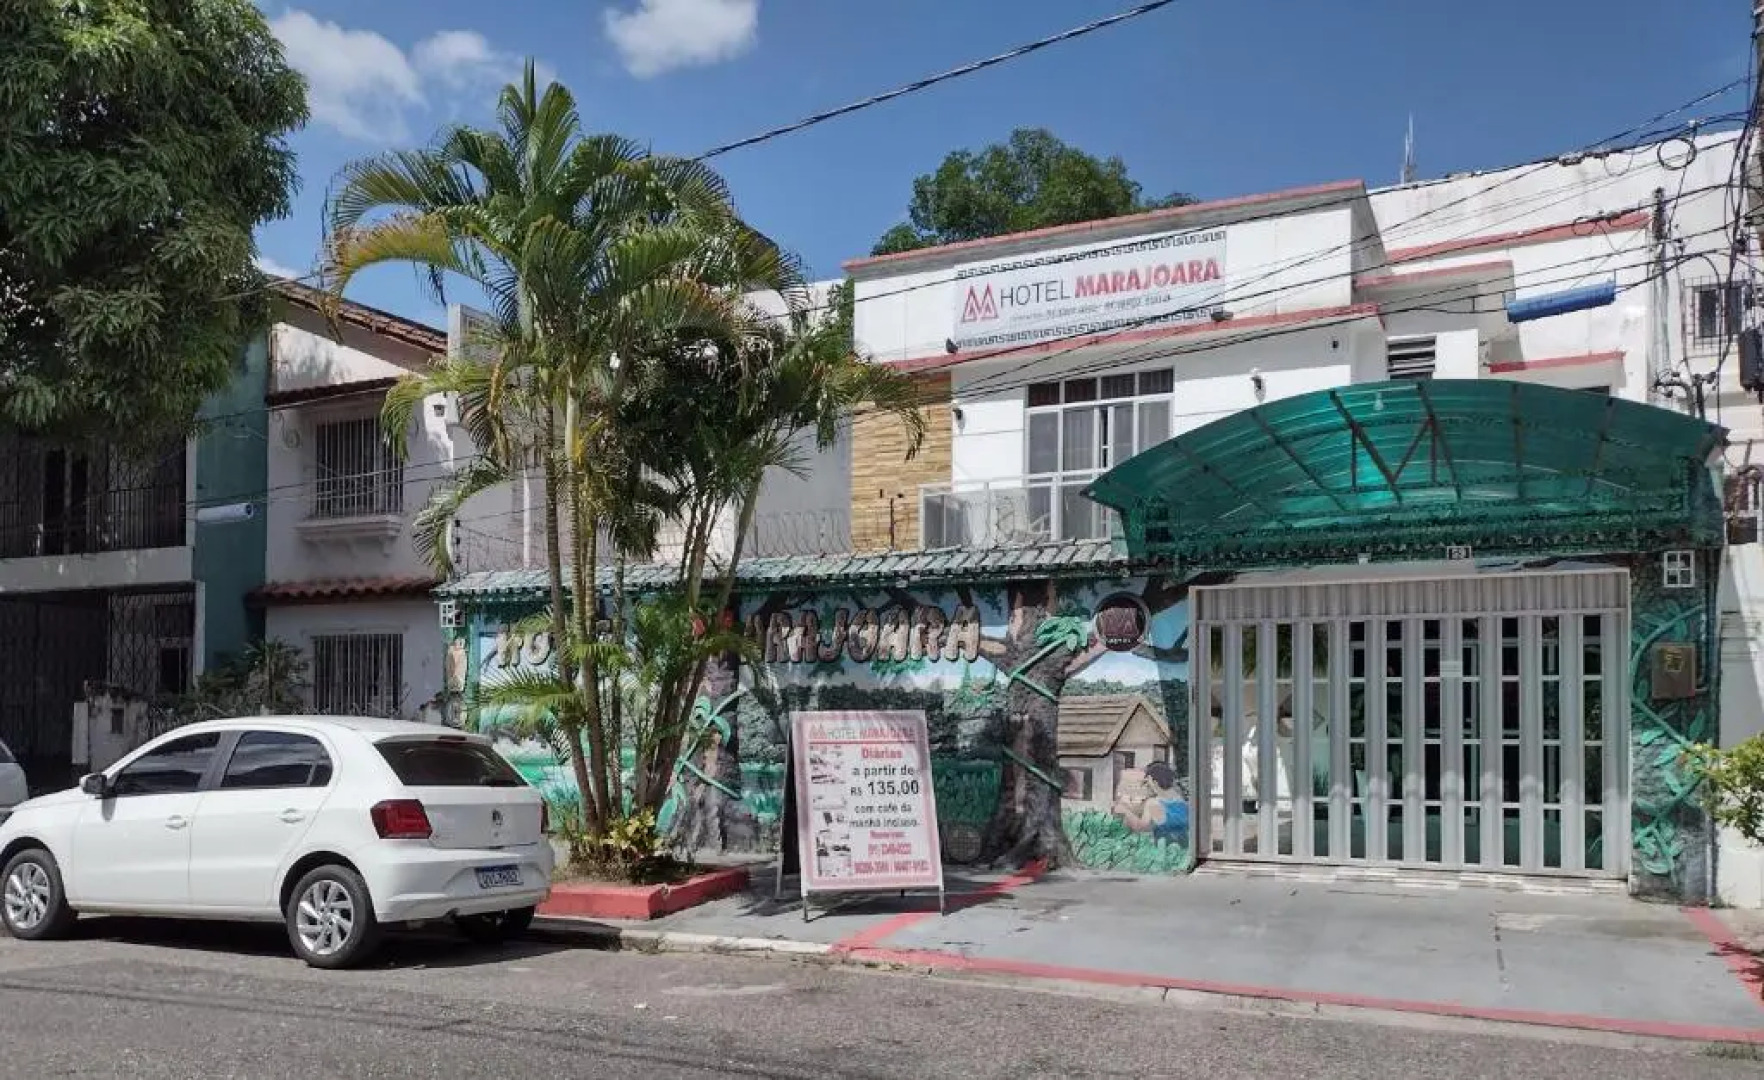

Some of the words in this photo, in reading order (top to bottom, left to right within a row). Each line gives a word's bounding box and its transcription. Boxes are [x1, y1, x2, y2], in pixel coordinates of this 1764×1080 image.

[1000, 280, 1071, 308] HOTEL
[1074, 258, 1221, 299] MARAJOARA
[851, 766, 860, 776] a
[864, 764, 896, 778] partir
[900, 764, 914, 775] de
[850, 786, 862, 796] R$
[867, 779, 919, 797] 135,00
[854, 804, 874, 814] com
[900, 802, 912, 813] da
